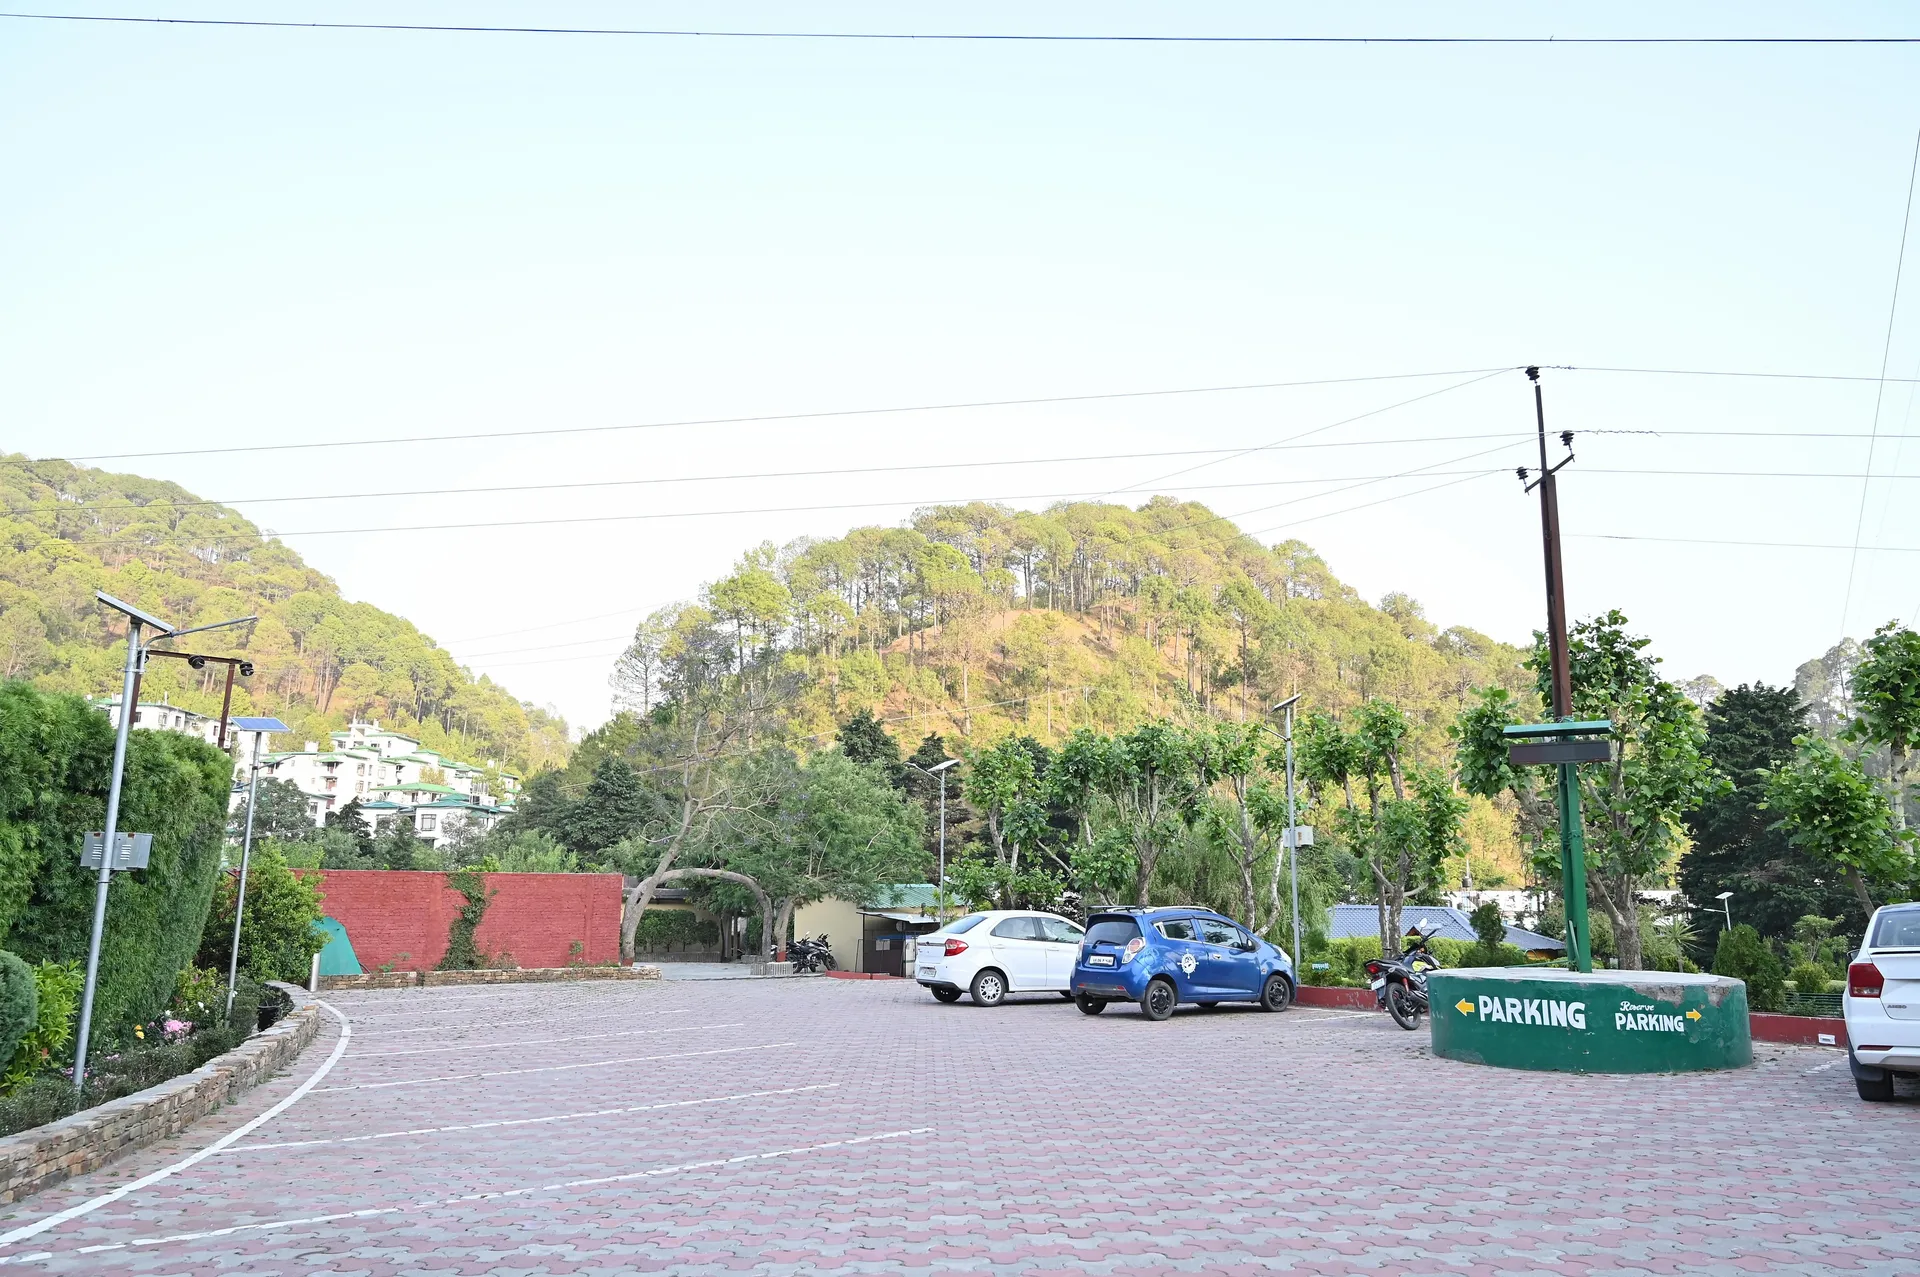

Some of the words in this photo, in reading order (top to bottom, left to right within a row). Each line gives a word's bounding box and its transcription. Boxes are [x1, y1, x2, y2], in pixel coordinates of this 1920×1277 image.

[1478, 995, 1586, 1030] PARKING
[1619, 1000, 1655, 1011] Reserve
[1615, 1012, 1684, 1032] PARKING
